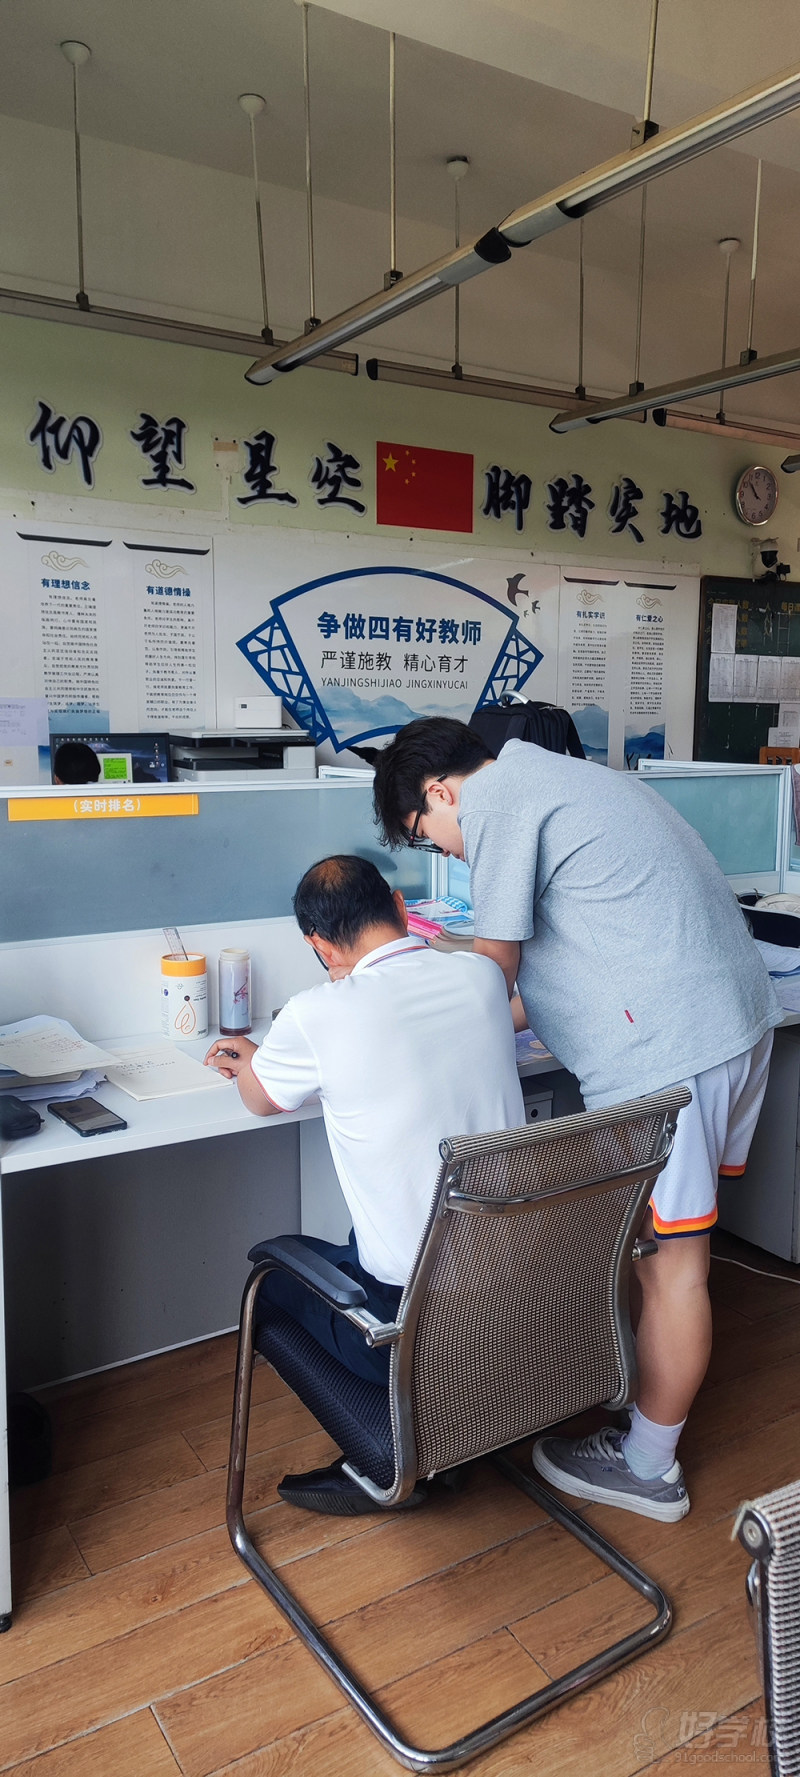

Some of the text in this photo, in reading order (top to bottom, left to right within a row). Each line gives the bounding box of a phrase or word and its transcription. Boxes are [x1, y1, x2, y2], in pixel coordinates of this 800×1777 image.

[29, 401, 366, 513] 仰望星空
[483, 466, 702, 543] 脚踏实地
[40, 577, 91, 591] 有理想信念
[146, 585, 191, 597] 有道德情操
[576, 610, 606, 620] 有扎实学识
[635, 614, 664, 623] 有仁爱之心
[316, 611, 482, 646] 争做四有好教师
[320, 650, 469, 673] 严谨施教 精心育才
[321, 677, 468, 690] YANJINGSHIJIAO JINGXINYUCAI
[73, 798, 141, 813] （实时排名）
